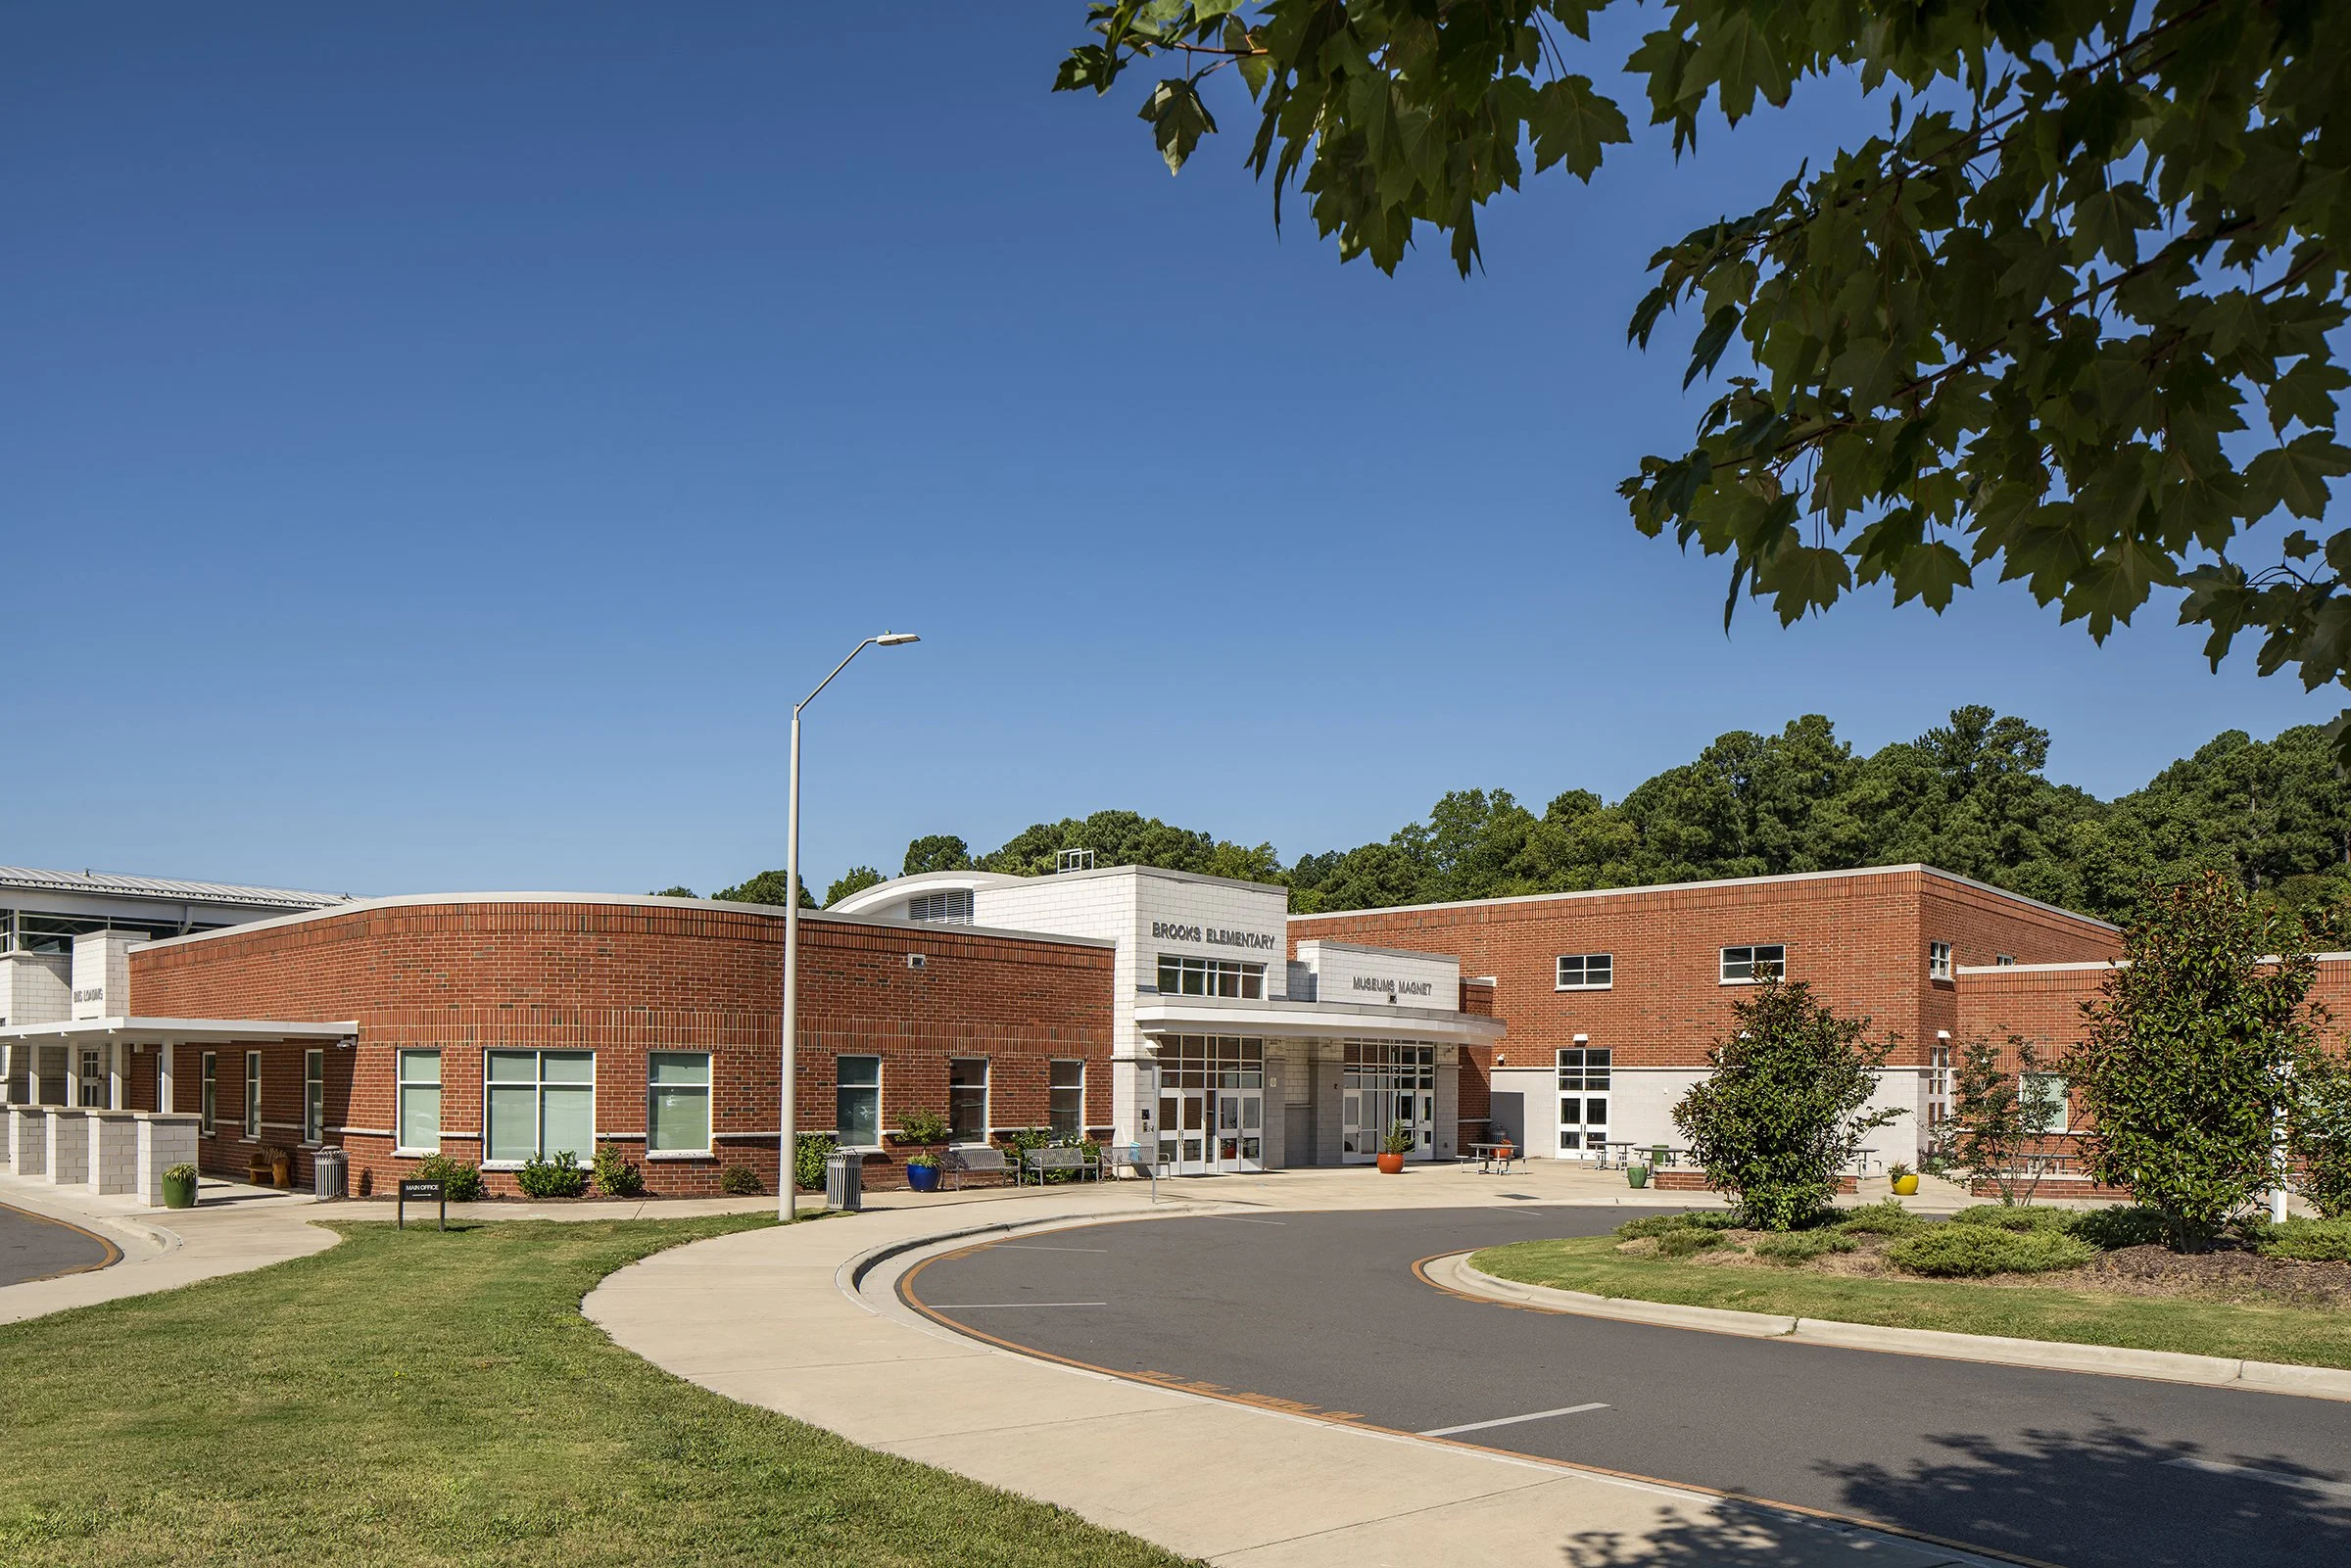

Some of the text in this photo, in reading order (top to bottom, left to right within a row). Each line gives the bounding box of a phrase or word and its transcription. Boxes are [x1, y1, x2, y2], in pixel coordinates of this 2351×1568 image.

[1152, 922, 1275, 950] BROOKS ELEMENTARY
[1353, 976, 1432, 996] MUSEUMS MAGNET
